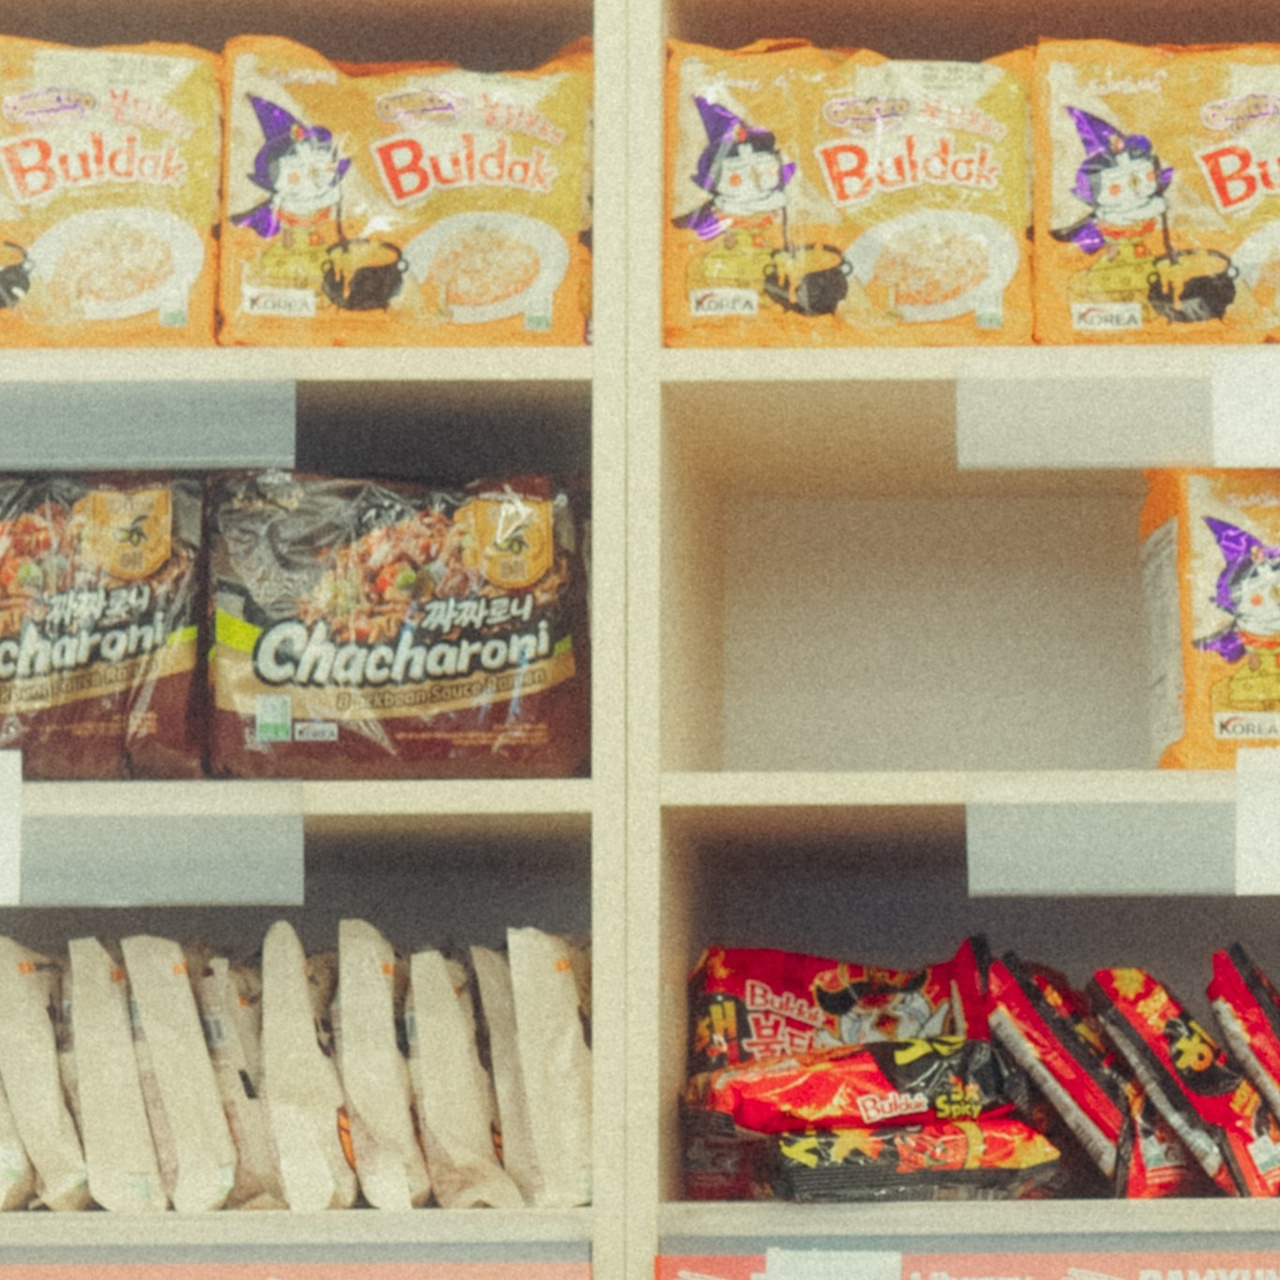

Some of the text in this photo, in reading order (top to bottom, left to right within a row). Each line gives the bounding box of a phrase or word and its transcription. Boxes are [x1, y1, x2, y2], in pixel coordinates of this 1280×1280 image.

[3, 132, 186, 198] Buldak
[377, 135, 554, 202] Buldak
[820, 137, 999, 200] Buldak
[249, 296, 311, 313] KOREA
[693, 295, 757, 313] KOREA
[1076, 308, 1141, 328] KOREA
[255, 618, 550, 685] Chacharoni
[1219, 718, 1280, 737] KOREA
